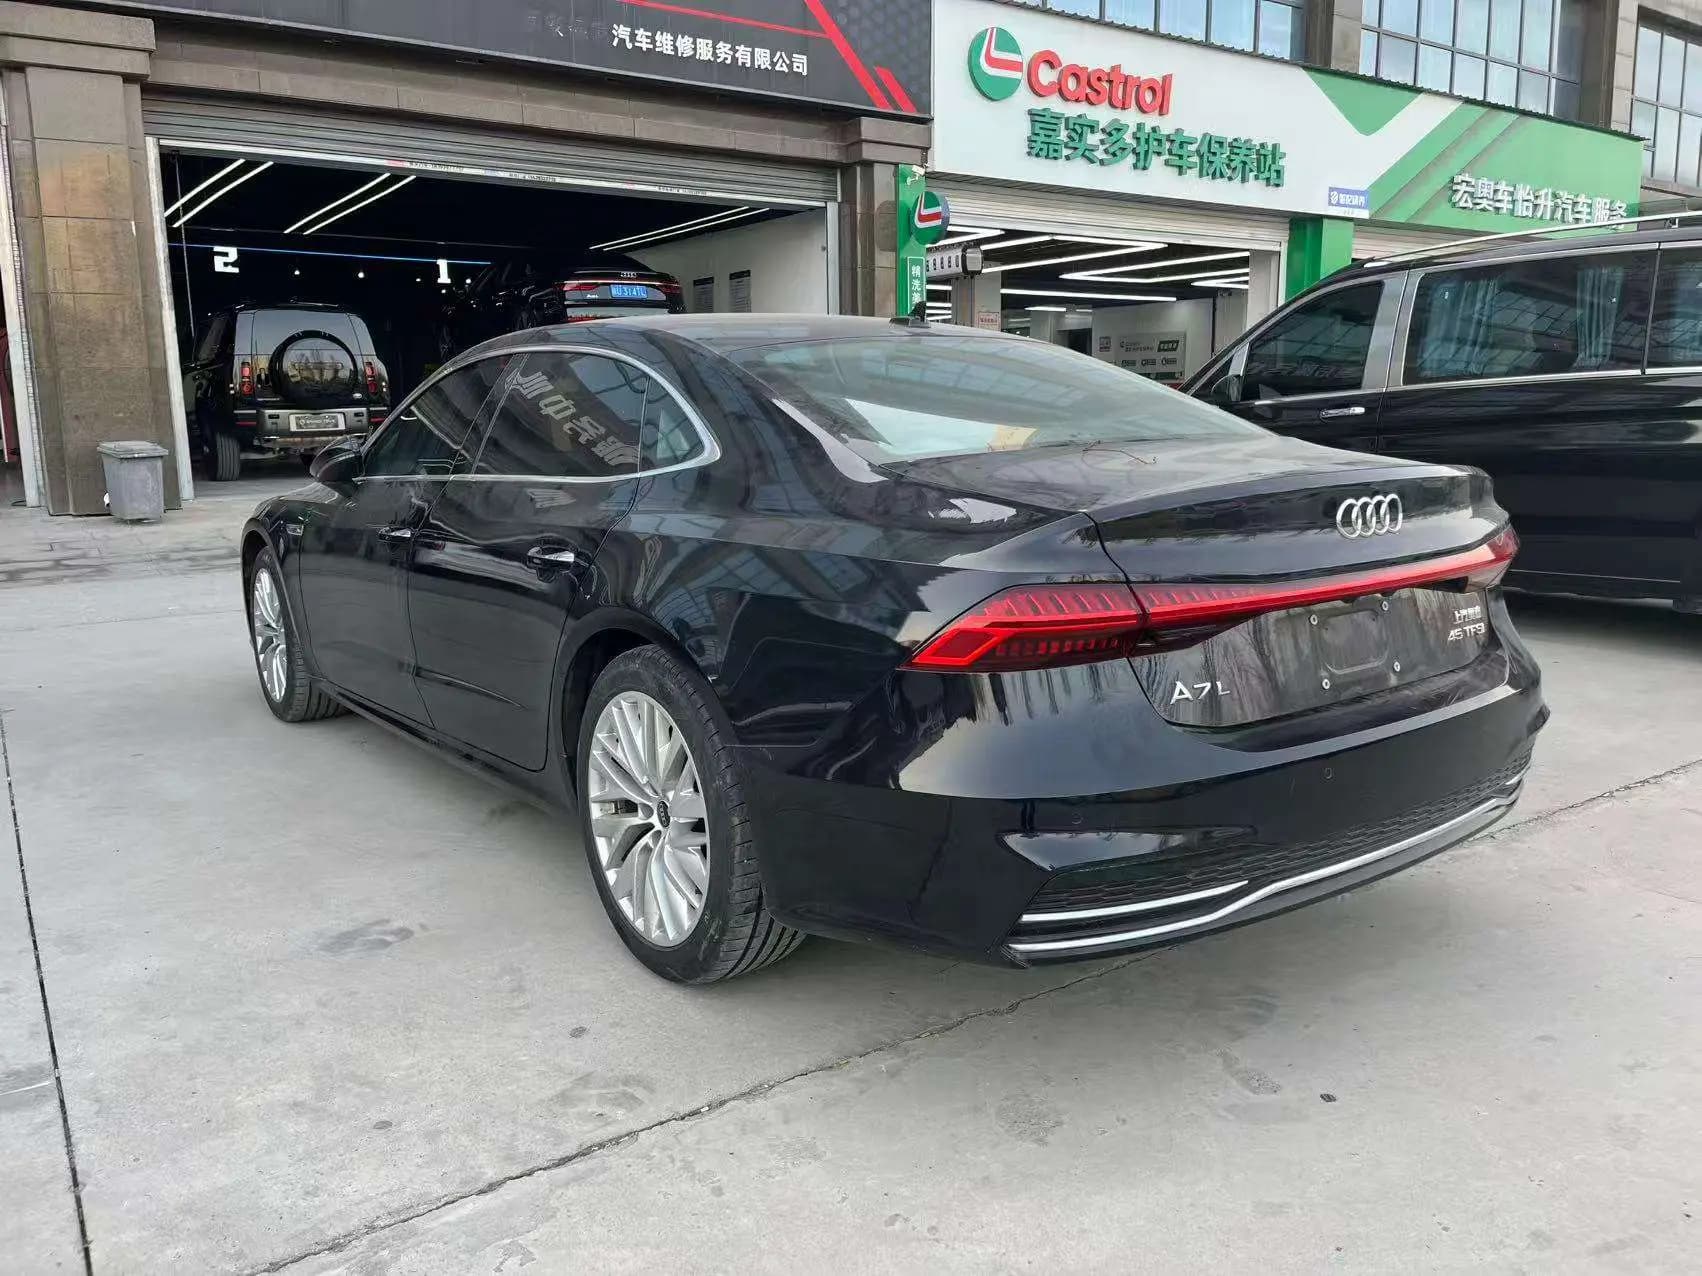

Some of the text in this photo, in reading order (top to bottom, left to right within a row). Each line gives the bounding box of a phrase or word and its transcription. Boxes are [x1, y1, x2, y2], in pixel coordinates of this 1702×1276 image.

[611, 23, 808, 76] 汽车维修服务有限公司
[1027, 49, 1173, 116] Castrol
[1027, 107, 1287, 187] 嘉实多护车保养站
[213, 246, 240, 273] 2
[436, 258, 451, 283] 1
[1170, 680, 1231, 705] A7L
